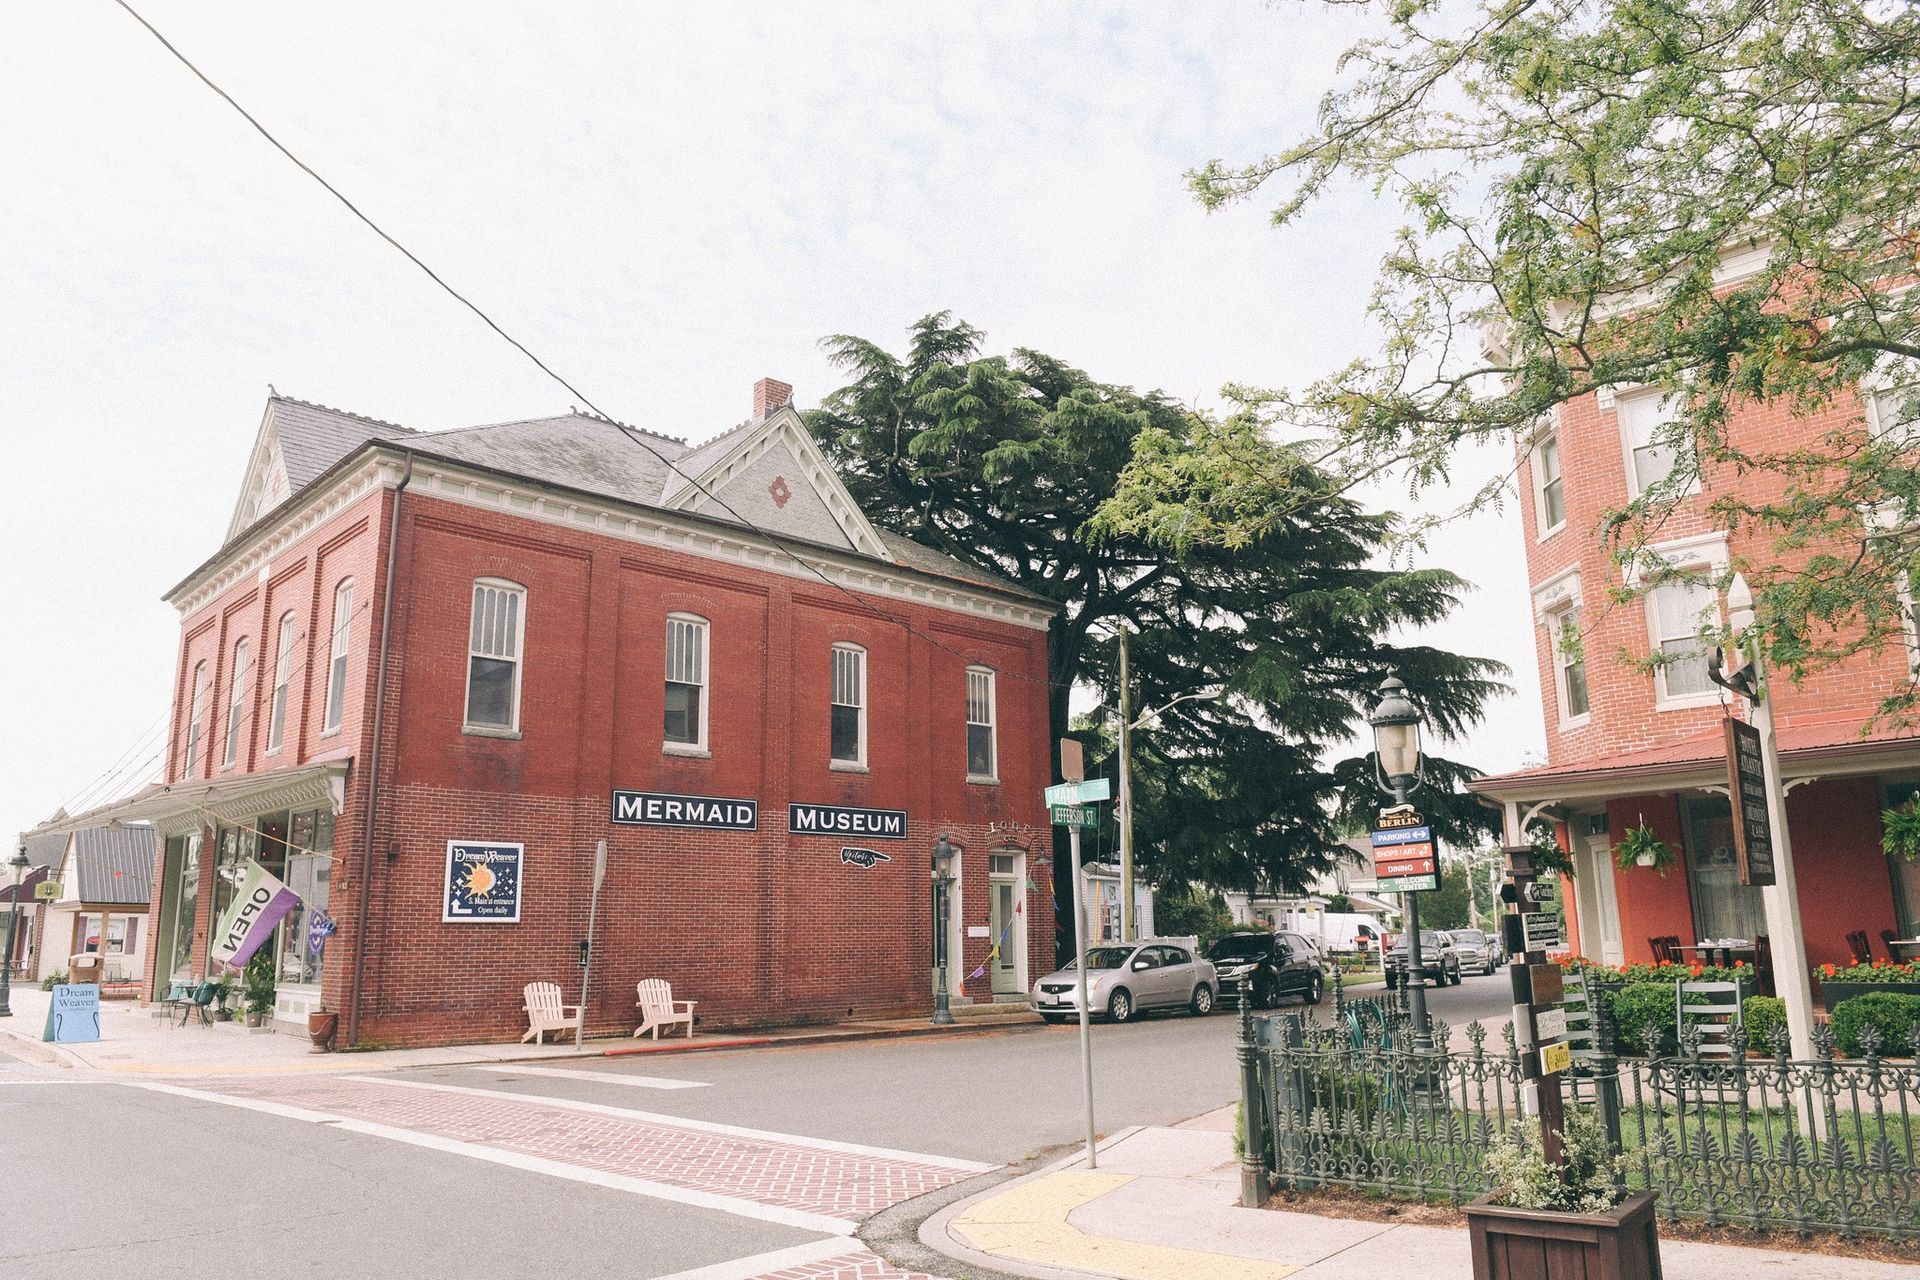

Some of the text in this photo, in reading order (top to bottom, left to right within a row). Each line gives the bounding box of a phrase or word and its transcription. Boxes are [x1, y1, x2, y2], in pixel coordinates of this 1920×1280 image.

[617, 795, 754, 825] MERMAID
[796, 808, 900, 833] MUSEUM
[1054, 807, 1094, 825] JEFFERSON ST
[1378, 816, 1420, 828] BERLIN
[1377, 832, 1411, 842] PARKING
[454, 848, 518, 863] Dream Weaver
[1376, 850, 1398, 858] SHOPS
[1387, 864, 1414, 873] DINING
[1394, 876, 1431, 885] WELCOME
[1398, 883, 1428, 891] CENTER
[474, 897, 488, 905] Main
[477, 906, 508, 915] Open daily
[60, 987, 95, 997] Dream
[59, 997, 96, 1007] Weaver
